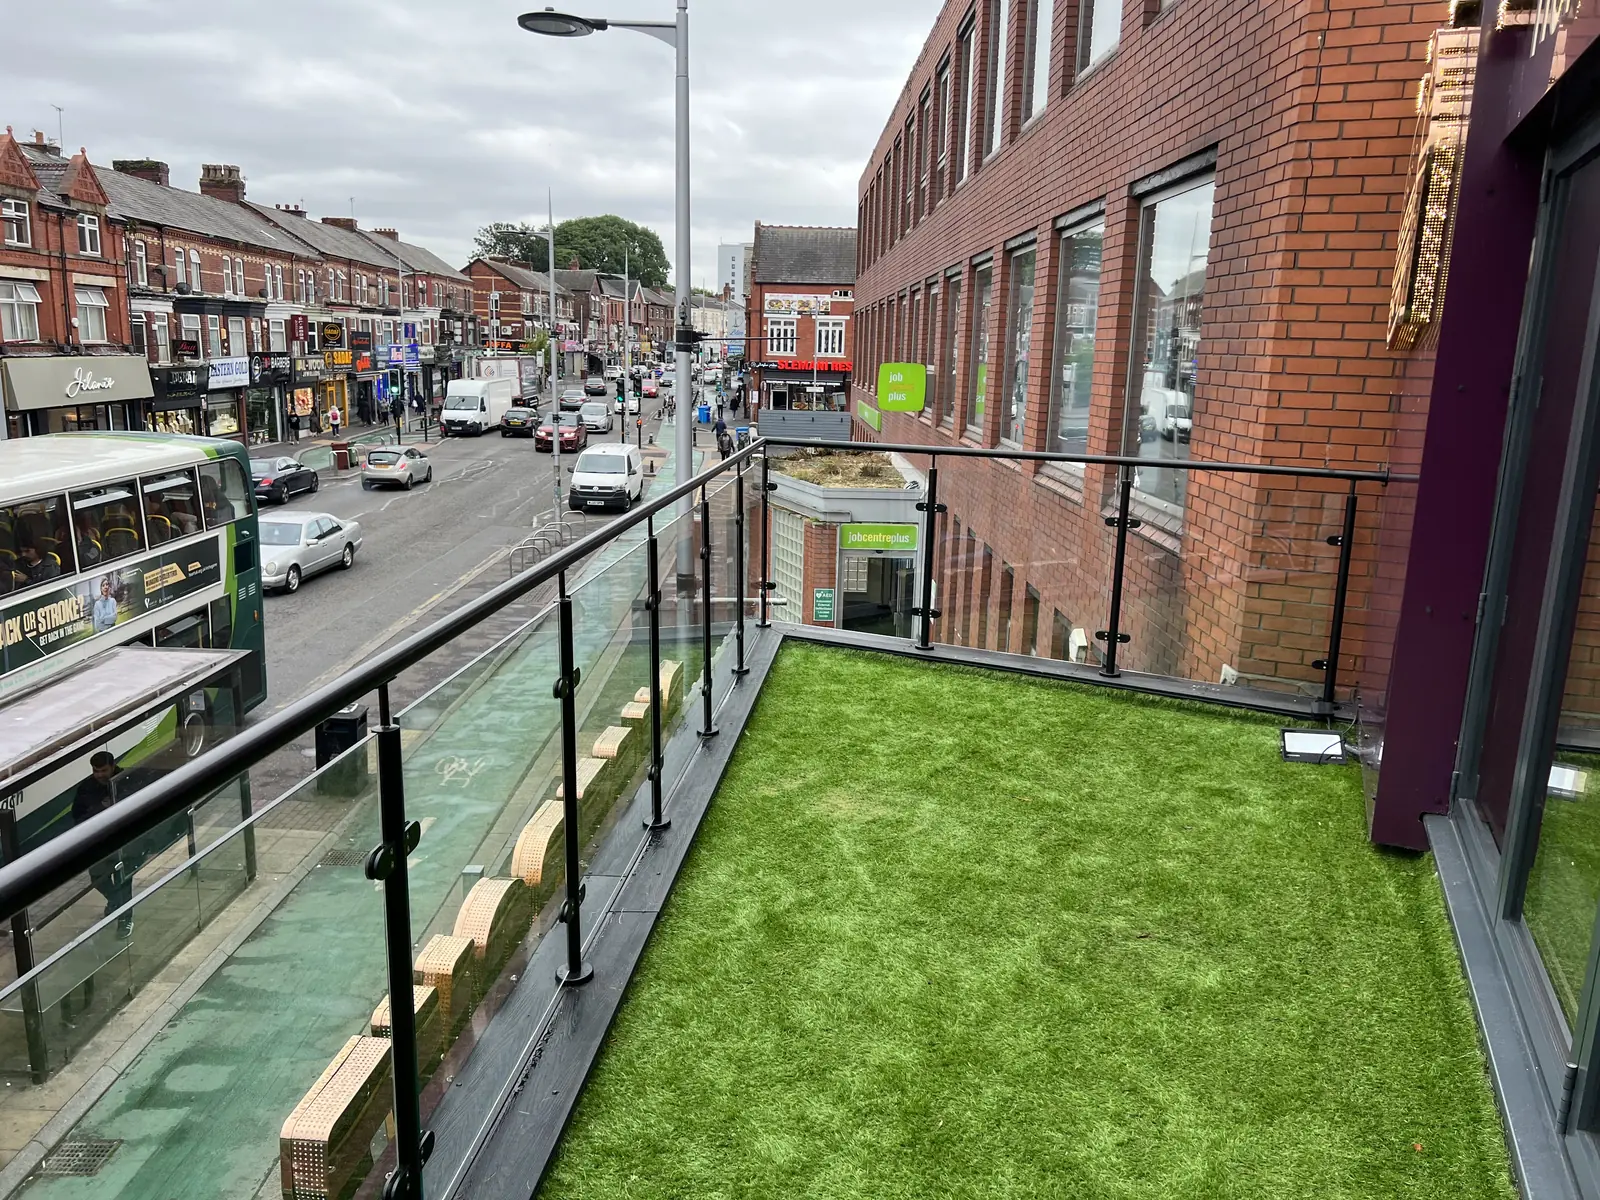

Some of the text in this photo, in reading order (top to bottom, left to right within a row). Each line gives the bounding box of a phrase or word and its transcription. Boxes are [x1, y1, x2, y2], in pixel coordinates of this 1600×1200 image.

[333, 351, 352, 365] SADAF
[210, 361, 248, 377] EASTERN GOLD
[777, 360, 829, 371] SLEMANI
[889, 372, 903, 383] job
[888, 392, 907, 402] plus
[847, 532, 910, 545] jobcentreplus
[23, 611, 37, 633] OR
[37, 594, 85, 633] STROKE?
[39, 634, 49, 647] GET
[47, 631, 60, 643] BACK
[59, 628, 66, 639] IN
[64, 624, 74, 636] THE
